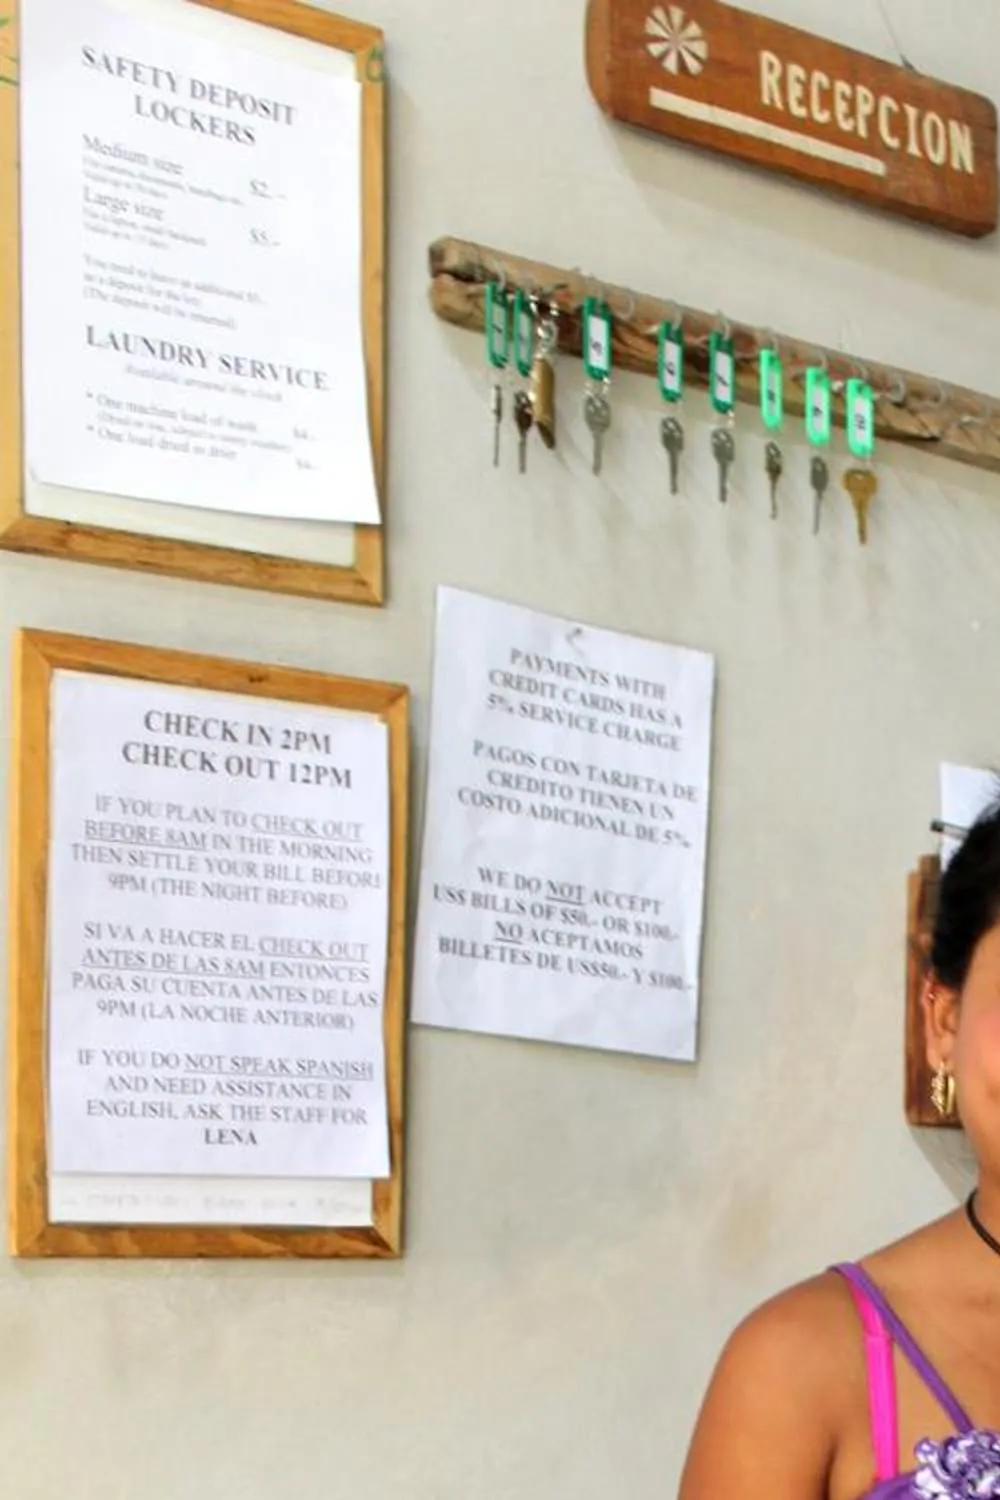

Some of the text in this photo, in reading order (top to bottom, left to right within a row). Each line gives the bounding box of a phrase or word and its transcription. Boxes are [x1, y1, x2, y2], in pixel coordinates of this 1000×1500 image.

[81, 45, 297, 127] SAFETY DEPOSIT
[134, 94, 256, 147] LOCKERS
[759, 49, 977, 175] RECEPCION
[85, 323, 331, 391] LAUNDRY SERVICE
[509, 646, 668, 702] PAYMENTS WITH
[487, 668, 684, 730] CREDIT CARDS HAS A
[143, 708, 333, 756] CHECK IN 2PM
[517, 700, 600, 736] SERVICE
[602, 719, 682, 753] CHARGE
[121, 740, 353, 790] CHECK OUT 12PM
[471, 738, 700, 803] PAGOS CON TARJETA DE
[94, 793, 365, 844] IF YOU PLAN TO CHECK OUT
[457, 785, 522, 816] COSTO
[527, 802, 634, 838] ADICIONAL
[634, 824, 661, 844] DE
[486, 768, 676, 822] CREDITO TIENEN UN
[71, 843, 124, 867] THEN
[126, 850, 199, 874] SETTLE
[203, 857, 260, 880] YOUR
[262, 863, 304, 885] BILL
[83, 818, 374, 866] BEFORE 8AM IN THE MORNING
[106, 873, 150, 895] 9PM
[150, 874, 199, 899] (THE
[200, 881, 265, 905] NIGHT
[469, 890, 528, 916] BILLS
[530, 900, 557, 922] OF
[601, 914, 631, 936] OR
[476, 865, 665, 917] WE DO NOT ACCEPT
[83, 921, 370, 964] SI VA A HACER EL CHECK OUT
[437, 934, 534, 967] BILLETES
[536, 951, 563, 973] DE
[493, 919, 645, 961] NO ACEPTAMOS
[71, 969, 380, 1010] PAGA SU CUENTA ANTES DE LAS
[80, 947, 147, 972] ANTES
[149, 952, 180, 975] DE
[182, 954, 221, 977] LAS
[269, 960, 371, 985] ENTONCES
[95, 999, 356, 1032] 9PM (LA NOCHE ANTERIOR)
[76, 1047, 375, 1082] IF YOU DO NOT SPEAK SPANISH
[103, 1074, 353, 1102] AND NEED ASSISTANCE IN
[182, 1102, 224, 1122] ASK
[228, 1103, 265, 1124] THE
[269, 1105, 331, 1126] STAFF
[331, 1106, 369, 1127] FOR
[203, 1127, 260, 1147] LENA
